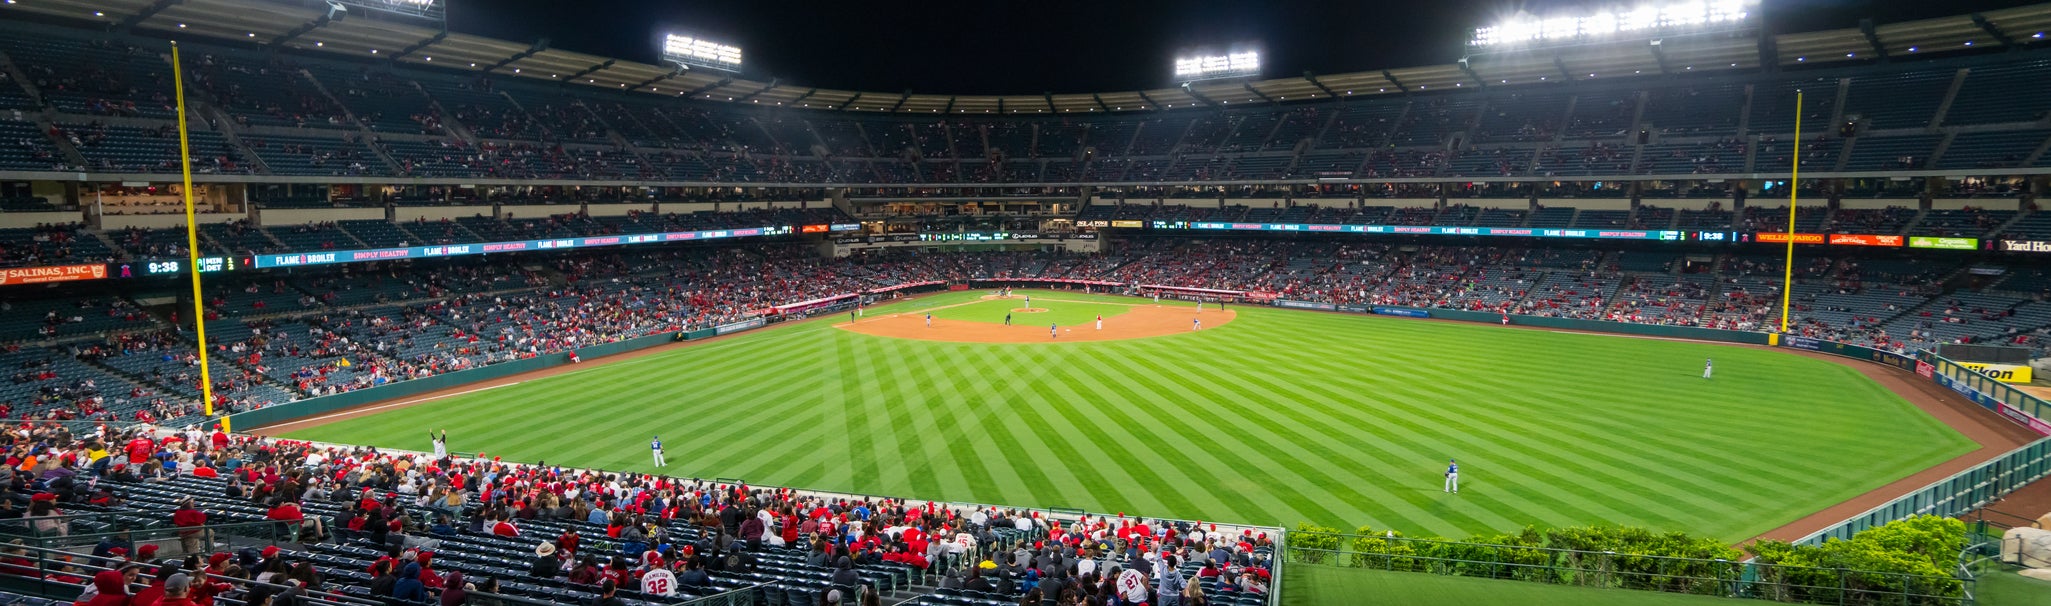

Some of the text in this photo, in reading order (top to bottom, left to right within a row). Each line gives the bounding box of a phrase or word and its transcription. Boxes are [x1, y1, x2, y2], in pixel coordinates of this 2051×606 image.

[2005, 240, 2030, 250] Yard
[424, 246, 470, 256] FLAME BROILER
[276, 254, 336, 264] FLAME BROILER
[9, 266, 90, 278] SALINAS, INC.
[148, 262, 178, 273] 9:38
[1968, 366, 2014, 380] ikon
[646, 572, 668, 582] HAMILTON
[1125, 574, 1138, 590] 27
[648, 578, 668, 594] 32
